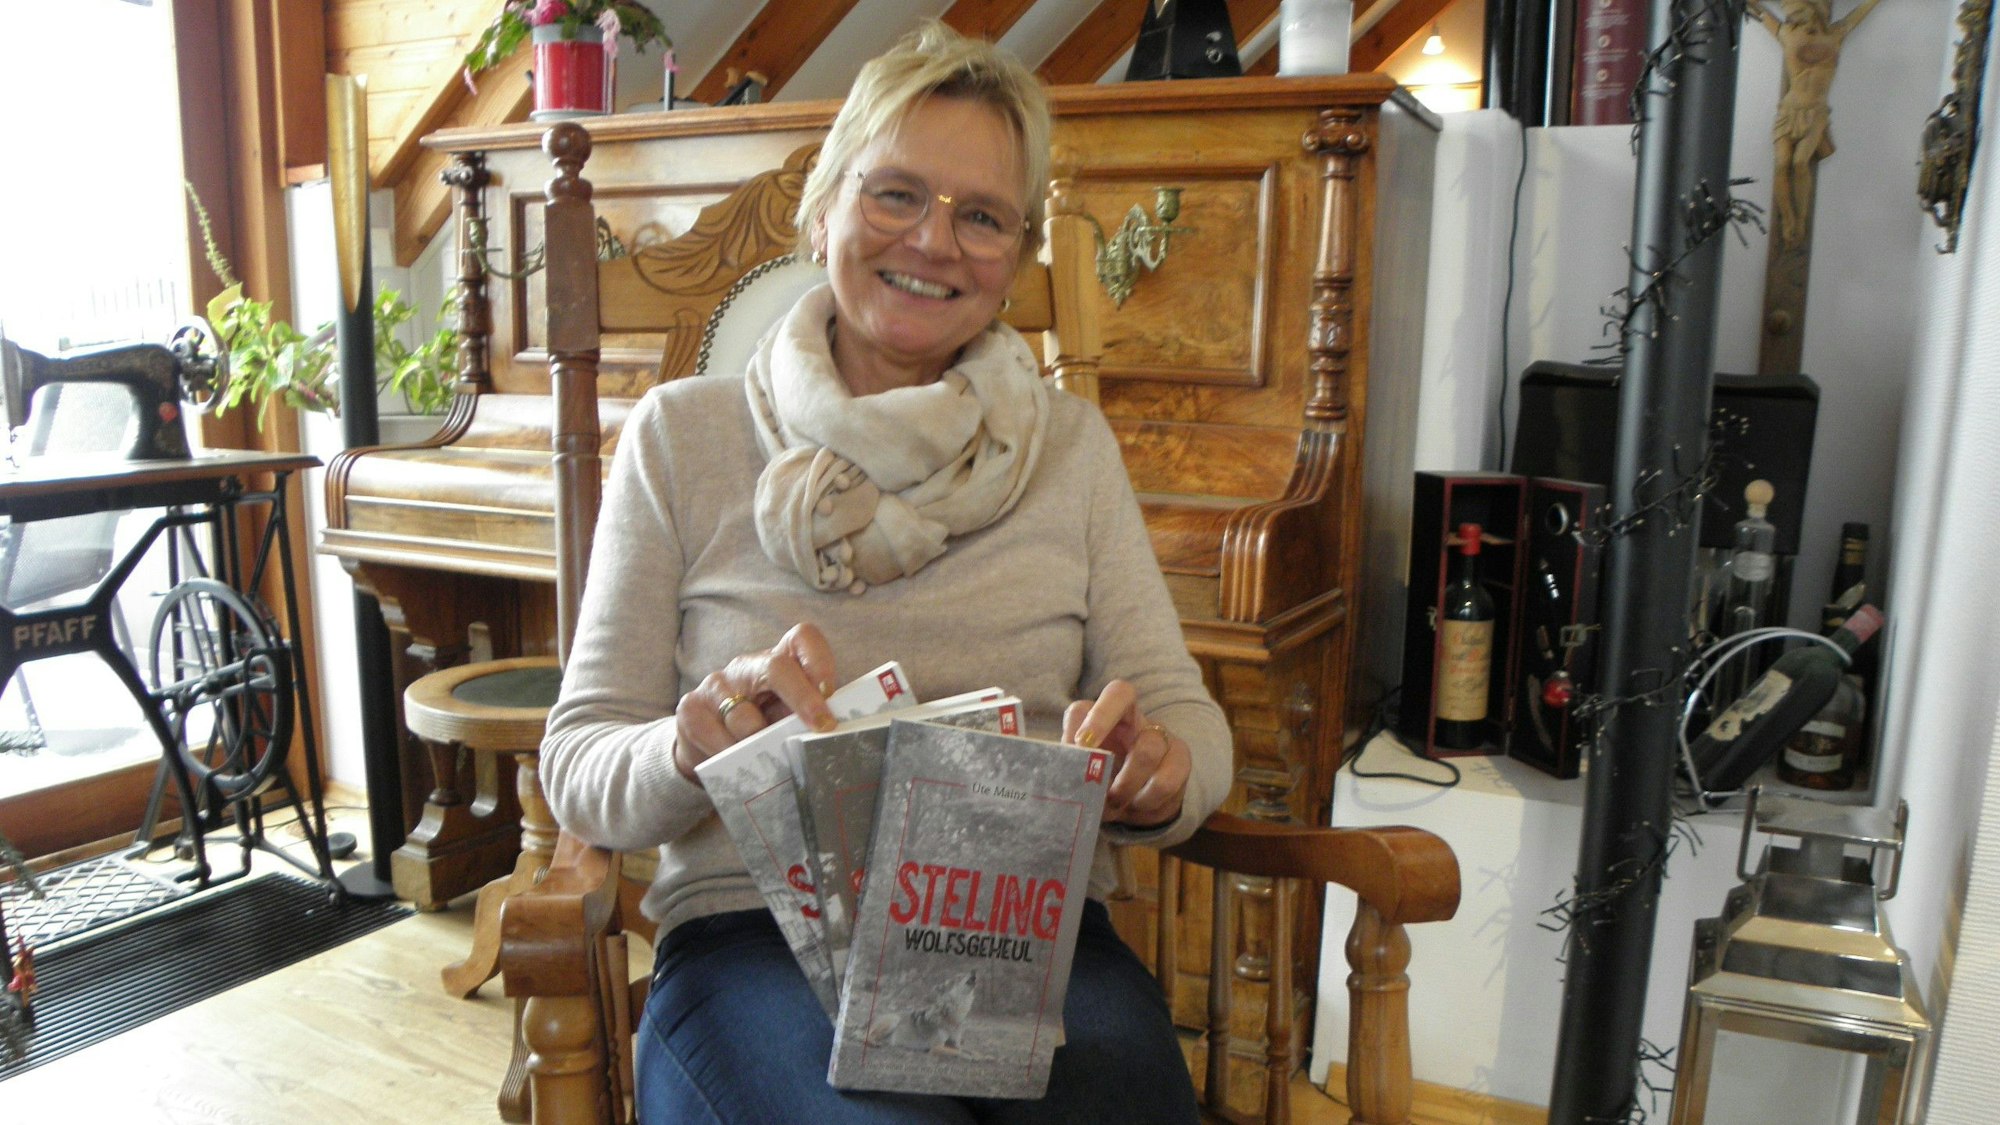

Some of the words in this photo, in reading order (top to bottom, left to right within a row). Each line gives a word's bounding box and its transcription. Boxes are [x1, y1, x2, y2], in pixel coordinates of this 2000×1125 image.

[14, 615, 96, 650] PFAFF
[972, 782, 991, 795] Ute
[993, 786, 1027, 800] Mainz
[889, 860, 1067, 941] STELING
[905, 928, 1033, 962] WOLFSGEHEUL
